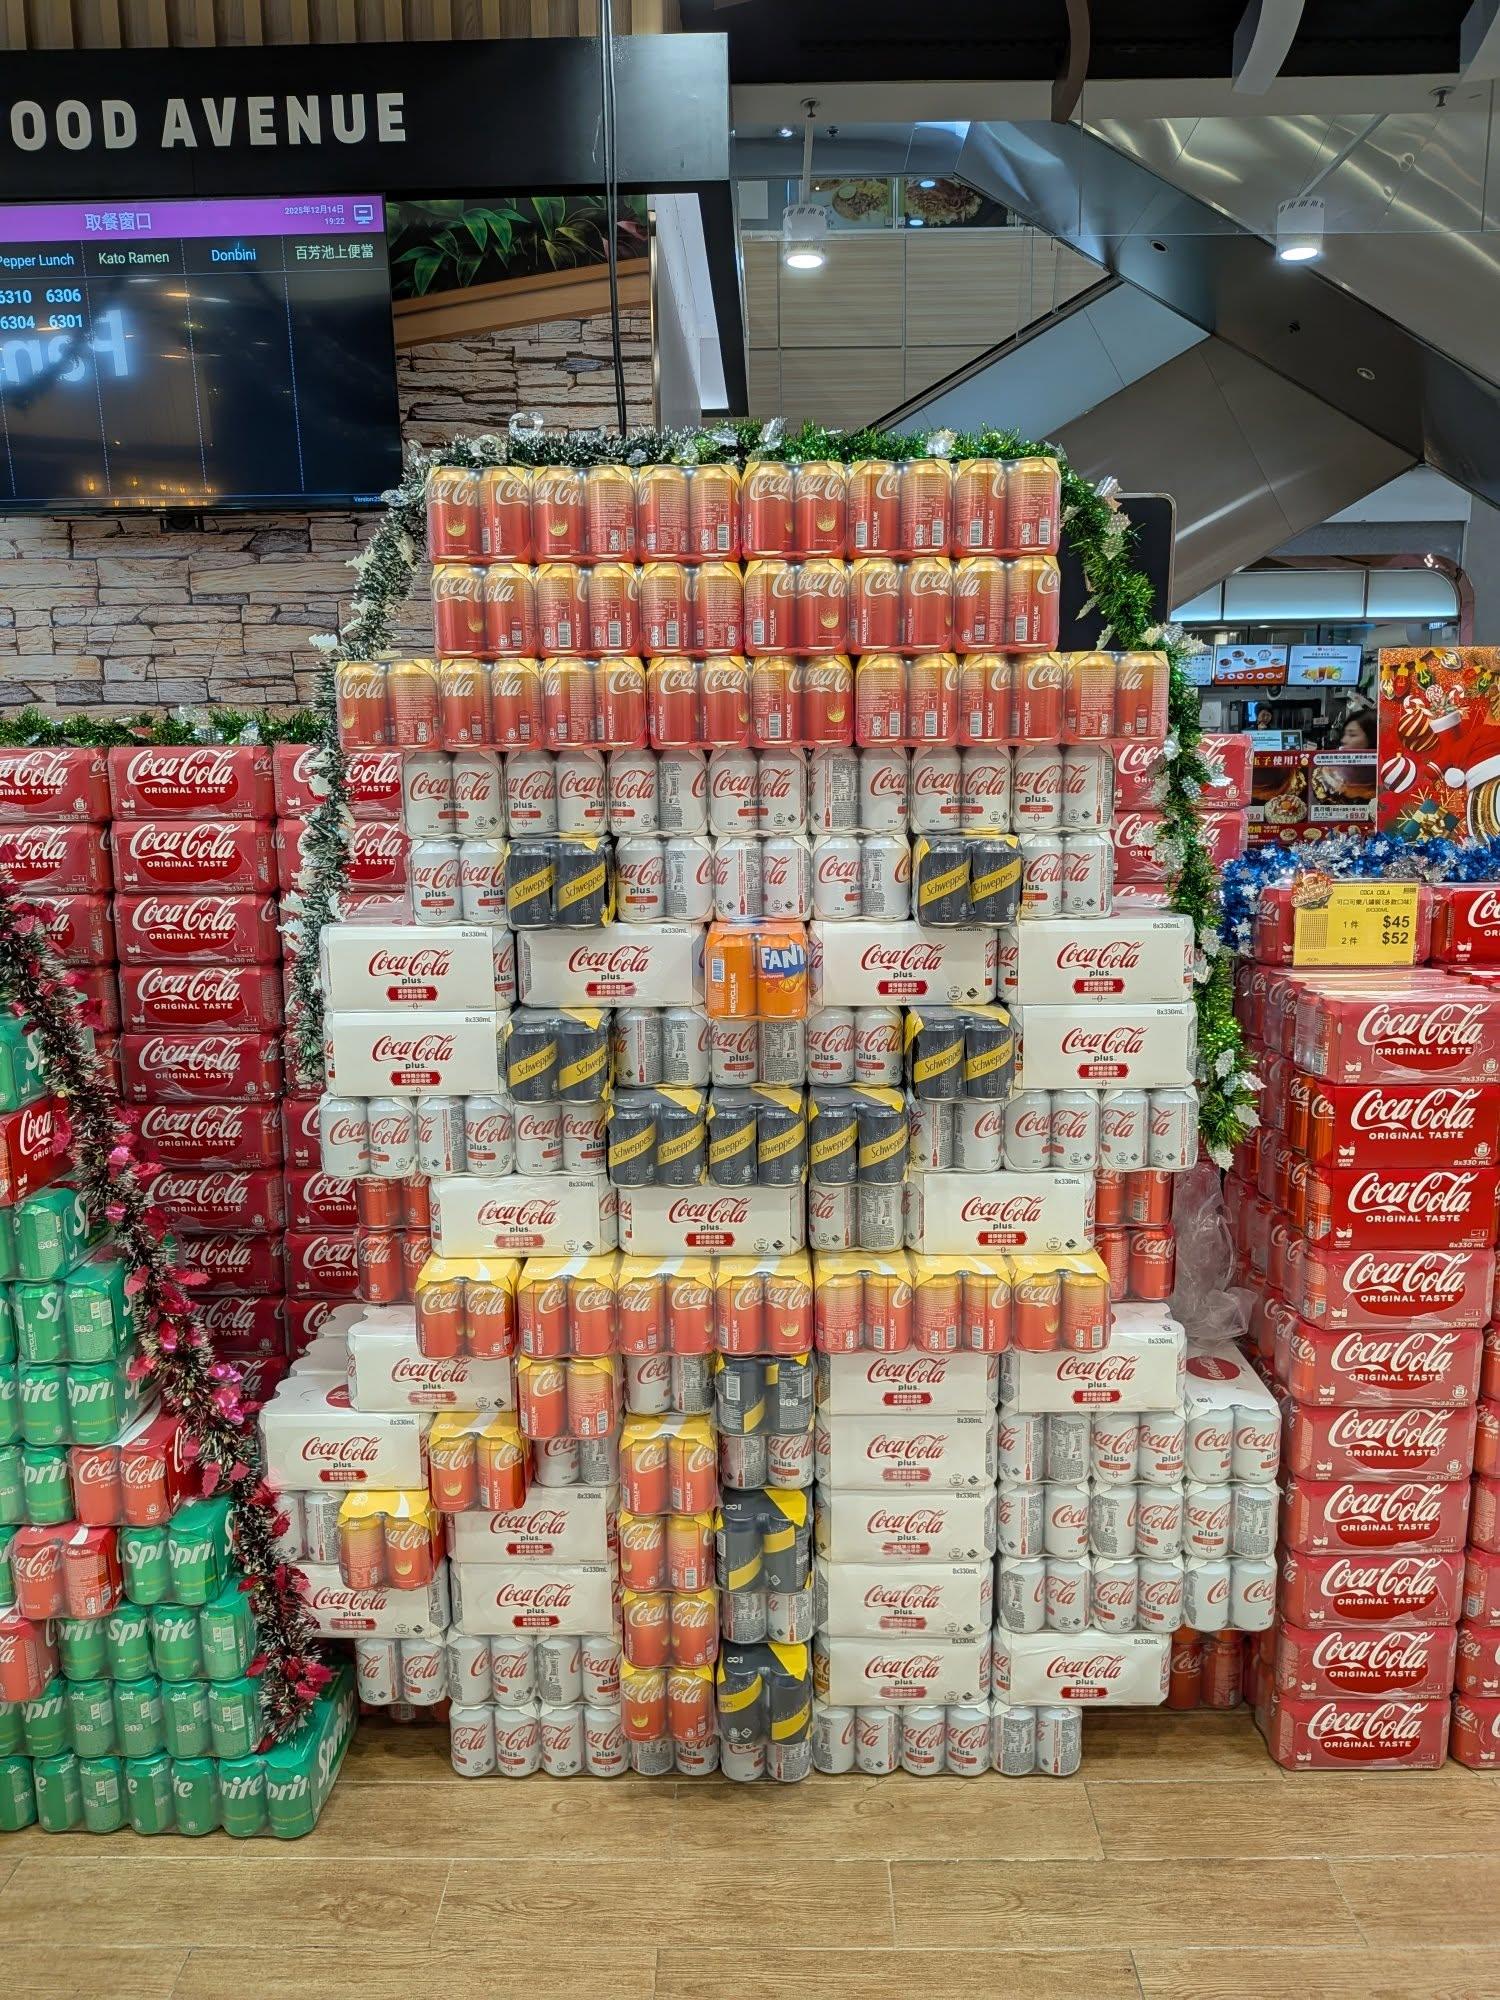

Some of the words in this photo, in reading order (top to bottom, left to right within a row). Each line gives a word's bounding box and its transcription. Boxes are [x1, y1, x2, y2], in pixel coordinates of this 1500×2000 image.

[10, 100, 137, 151] OOD
[161, 92, 406, 148] AVENUE
[84, 212, 152, 231] 取餐窗口
[324, 217, 346, 225] 19:22
[39, 252, 74, 267] Lunch
[99, 252, 125, 265] Kato
[129, 251, 170, 264] Ramen
[212, 248, 256, 262] Donbini
[295, 244, 374, 261] 百芳池上便當
[0, 290, 32, 304] 6310
[46, 289, 81, 303] 6306
[1, 314, 35, 330] 6304
[49, 314, 82, 329] 6301
[127, 749, 239, 785] Coca-Cola
[144, 787, 191, 795] ORIGINAL
[195, 787, 226, 795] TASTE
[130, 823, 241, 859] Coca-Cola
[147, 860, 193, 869] ORIGINAL
[197, 860, 228, 868] TASTE
[133, 897, 242, 932] Coca-Cola
[1351, 921, 1359, 929] 件
[1383, 915, 1410, 929] $45
[1350, 937, 1358, 945] 件
[1382, 931, 1409, 946] $52
[368, 949, 454, 977] Coca-Cola
[569, 946, 652, 972] Coca-Cola
[861, 943, 948, 971] Coca-Cola
[1057, 941, 1144, 969] Coca-Cola
[137, 968, 246, 1002] Coca-Cola
[402, 977, 422, 985] plus
[601, 972, 622, 981] plus
[1090, 969, 1111, 977] plus
[154, 1002, 199, 1010] ORIGINAL
[203, 1001, 233, 1010] TASTE
[1358, 1003, 1492, 1045] Coca-Cola
[372, 1034, 456, 1062] Coca-Cola
[1061, 1027, 1149, 1054] Coca-Cola
[1437, 1047, 1473, 1055] TASTE
[139, 1036, 247, 1072] Coca-Cola
[1094, 1054, 1115, 1062] plus
[1351, 1088, 1482, 1130] Coca-Cola
[142, 1105, 249, 1140] Coca-Cola
[1429, 1131, 1464, 1139] TASTE
[158, 1139, 203, 1147] ORIGINAL
[149, 1172, 253, 1205] Coca-Cola
[1348, 1172, 1478, 1213] Coca-Cola
[478, 1200, 560, 1225] Coca-Cola
[669, 1197, 751, 1223] Coca-Cola
[960, 1195, 1046, 1223] Coca-Cola
[1426, 1214, 1460, 1222] TASTE
[1342, 1252, 1472, 1293] Coca-Cola
[1420, 1294, 1454, 1302] TASTE
[1331, 1332, 1461, 1372] Coca-Cola
[391, 1358, 474, 1383] Coca-Cola
[867, 1358, 949, 1384] Coca-Cola
[1056, 1355, 1140, 1381] Coca-Cola
[1328, 1409, 1454, 1449] Coca-Cola
[302, 1436, 382, 1461] Coca-Cola
[867, 1434, 948, 1459] Coca-Cola
[1324, 1484, 1448, 1523] Coca-Cola
[490, 1510, 569, 1534] Coca-Cola
[867, 1509, 948, 1534] Coca-Cola
[1321, 1558, 1443, 1596] Coca-Cola
[496, 1584, 575, 1607] Coca-Cola
[864, 1584, 944, 1608] Coca-Cola
[1312, 1632, 1434, 1669] Coca-Cola
[864, 1656, 944, 1680] Coca-Cola
[1047, 1656, 1127, 1679] Coca-Cola
[1076, 1678, 1095, 1686] plus
[1307, 1703, 1428, 1740] Coca-Cola
